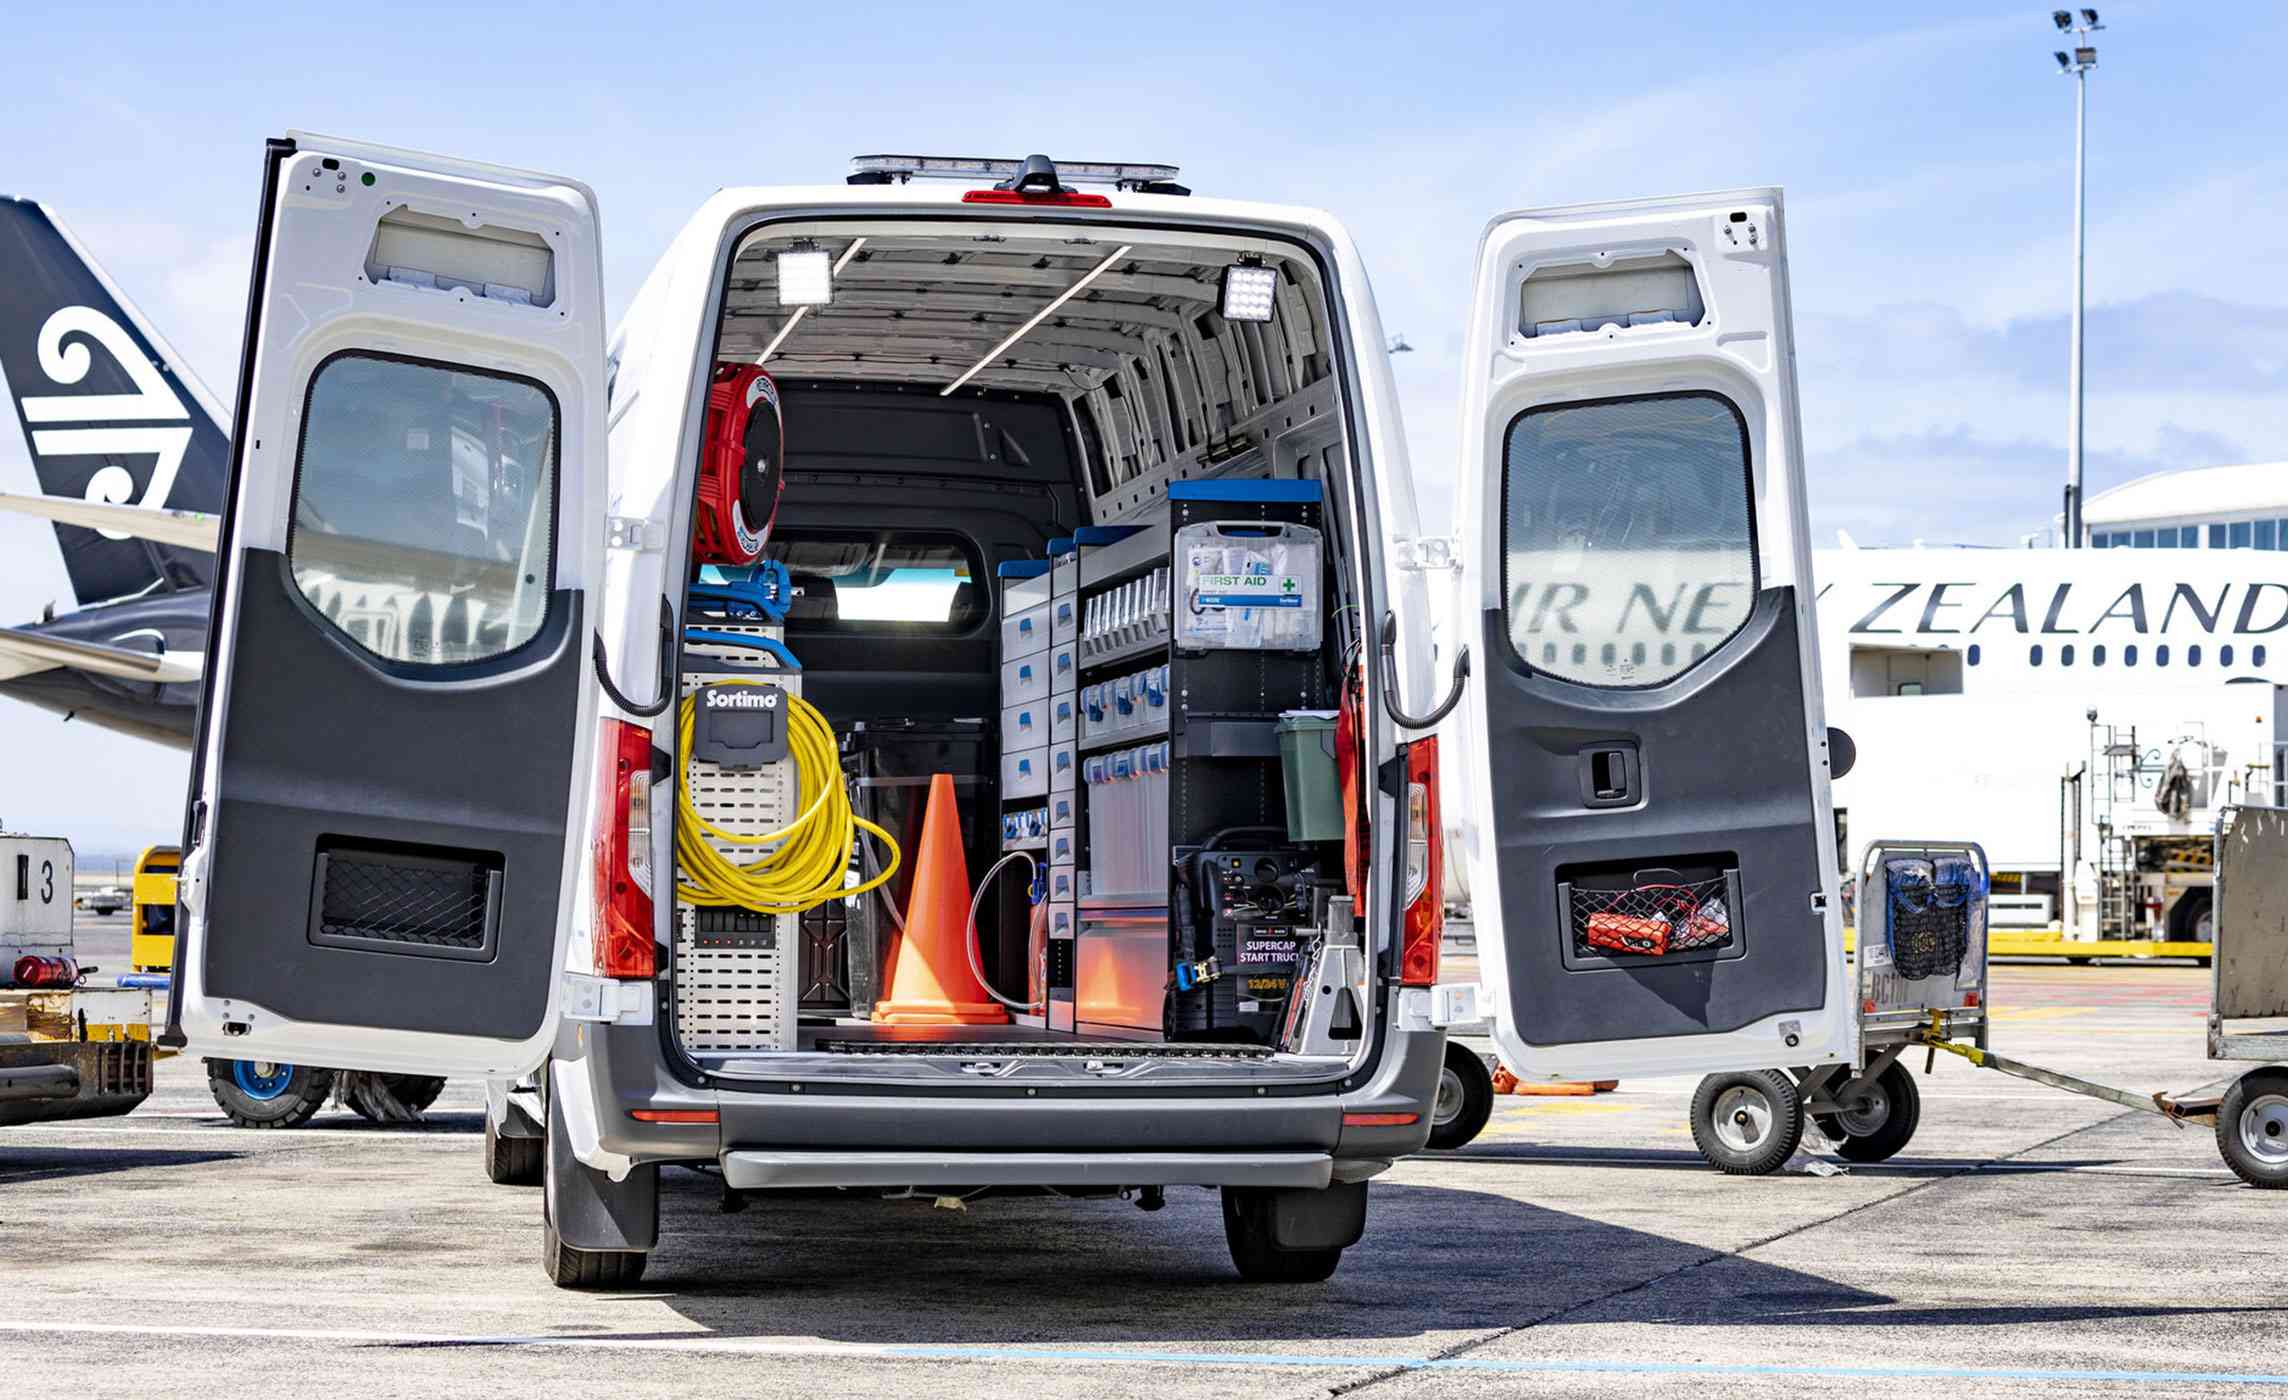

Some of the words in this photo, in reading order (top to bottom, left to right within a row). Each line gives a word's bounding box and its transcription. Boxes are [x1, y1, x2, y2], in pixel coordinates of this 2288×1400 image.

[1202, 576, 1240, 586] FIRST
[1243, 576, 1267, 586] AID
[1508, 582, 1590, 633] IR
[1848, 582, 2288, 634] ZEALAND
[706, 689, 778, 708] Sortimo
[1246, 941, 1296, 951] SUPERCAP
[1239, 952, 1269, 962] START
